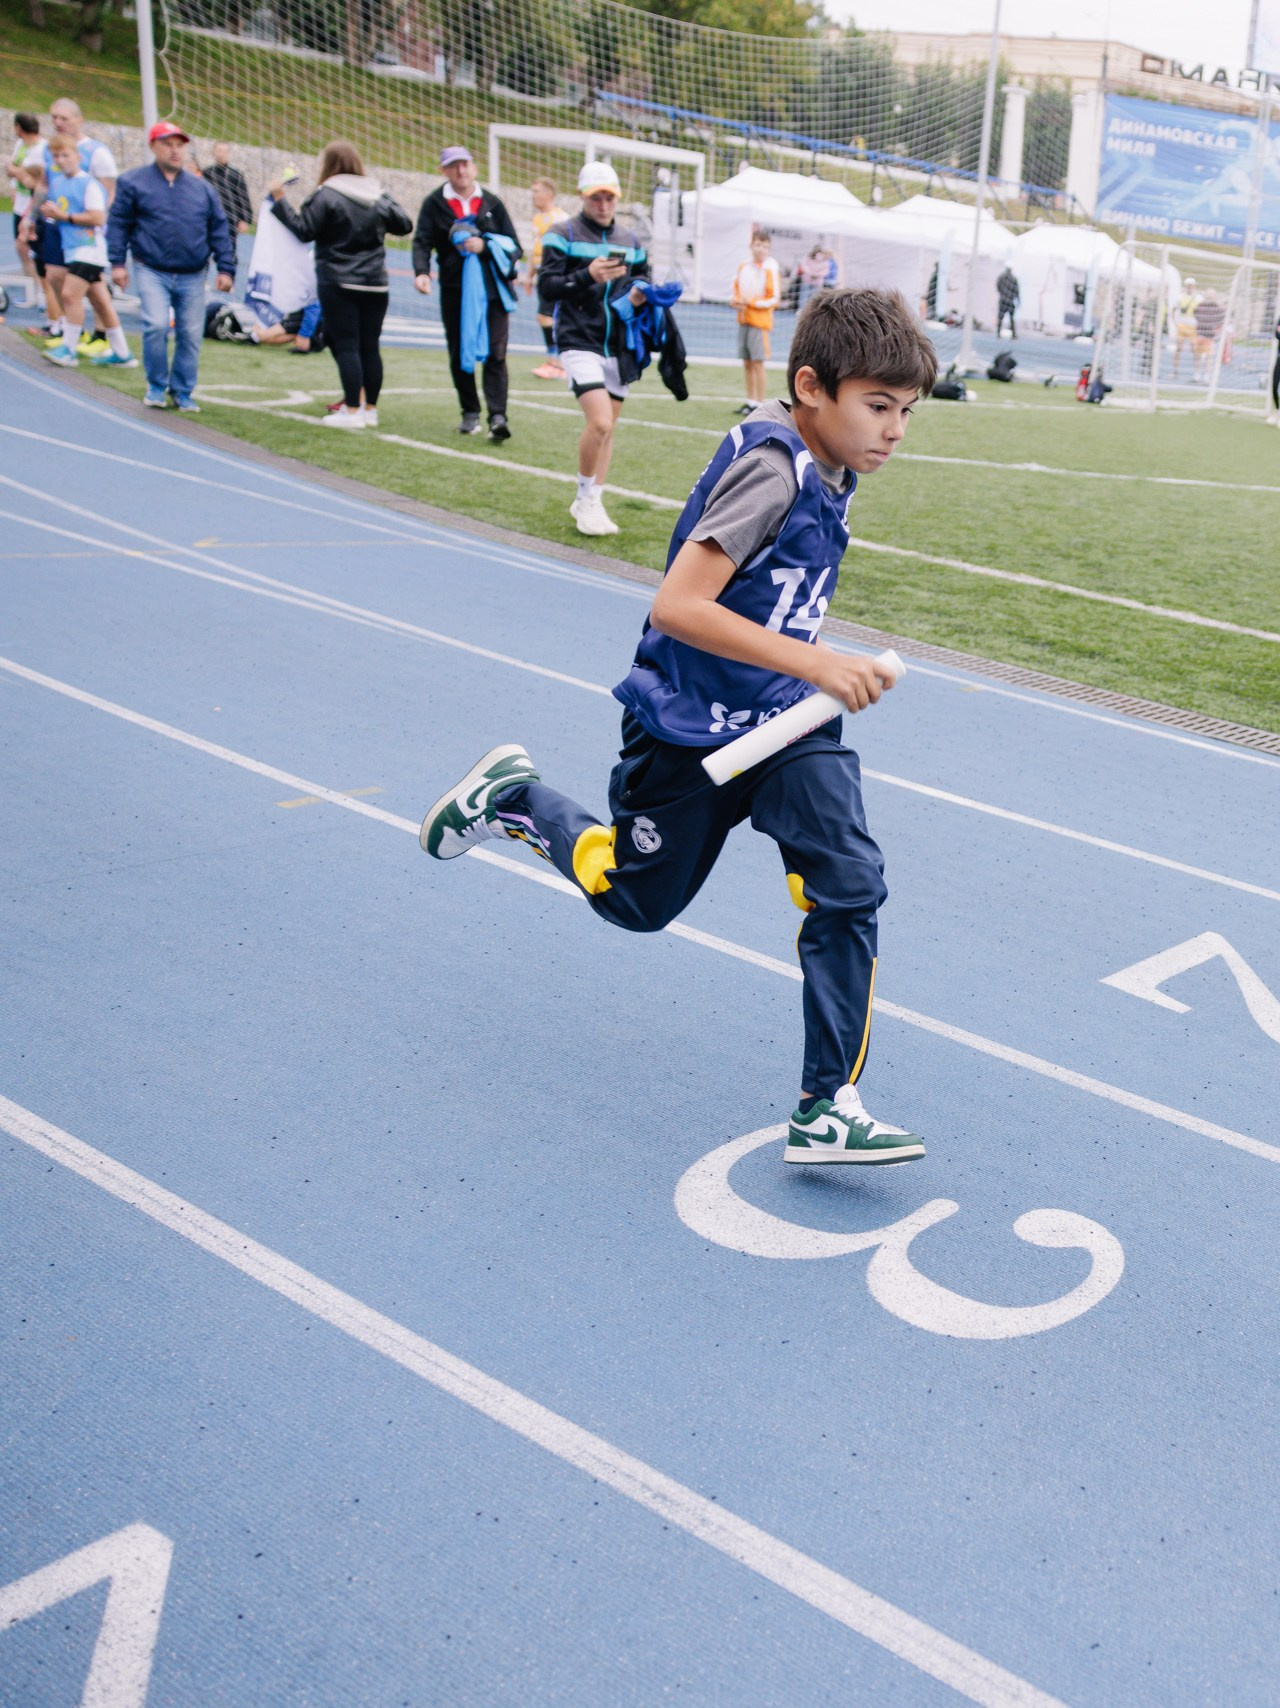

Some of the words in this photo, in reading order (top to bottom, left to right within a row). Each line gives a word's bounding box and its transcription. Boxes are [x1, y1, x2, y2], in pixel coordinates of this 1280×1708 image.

[1106, 136, 1157, 158] МИЛЯ
[1108, 117, 1238, 150] ДИНАМОВСКАЯ
[1101, 208, 1170, 231] ДИНАМО
[1172, 218, 1226, 240] БЕЖИТ
[765, 567, 832, 644] 14
[674, 1122, 1126, 1341] 3
